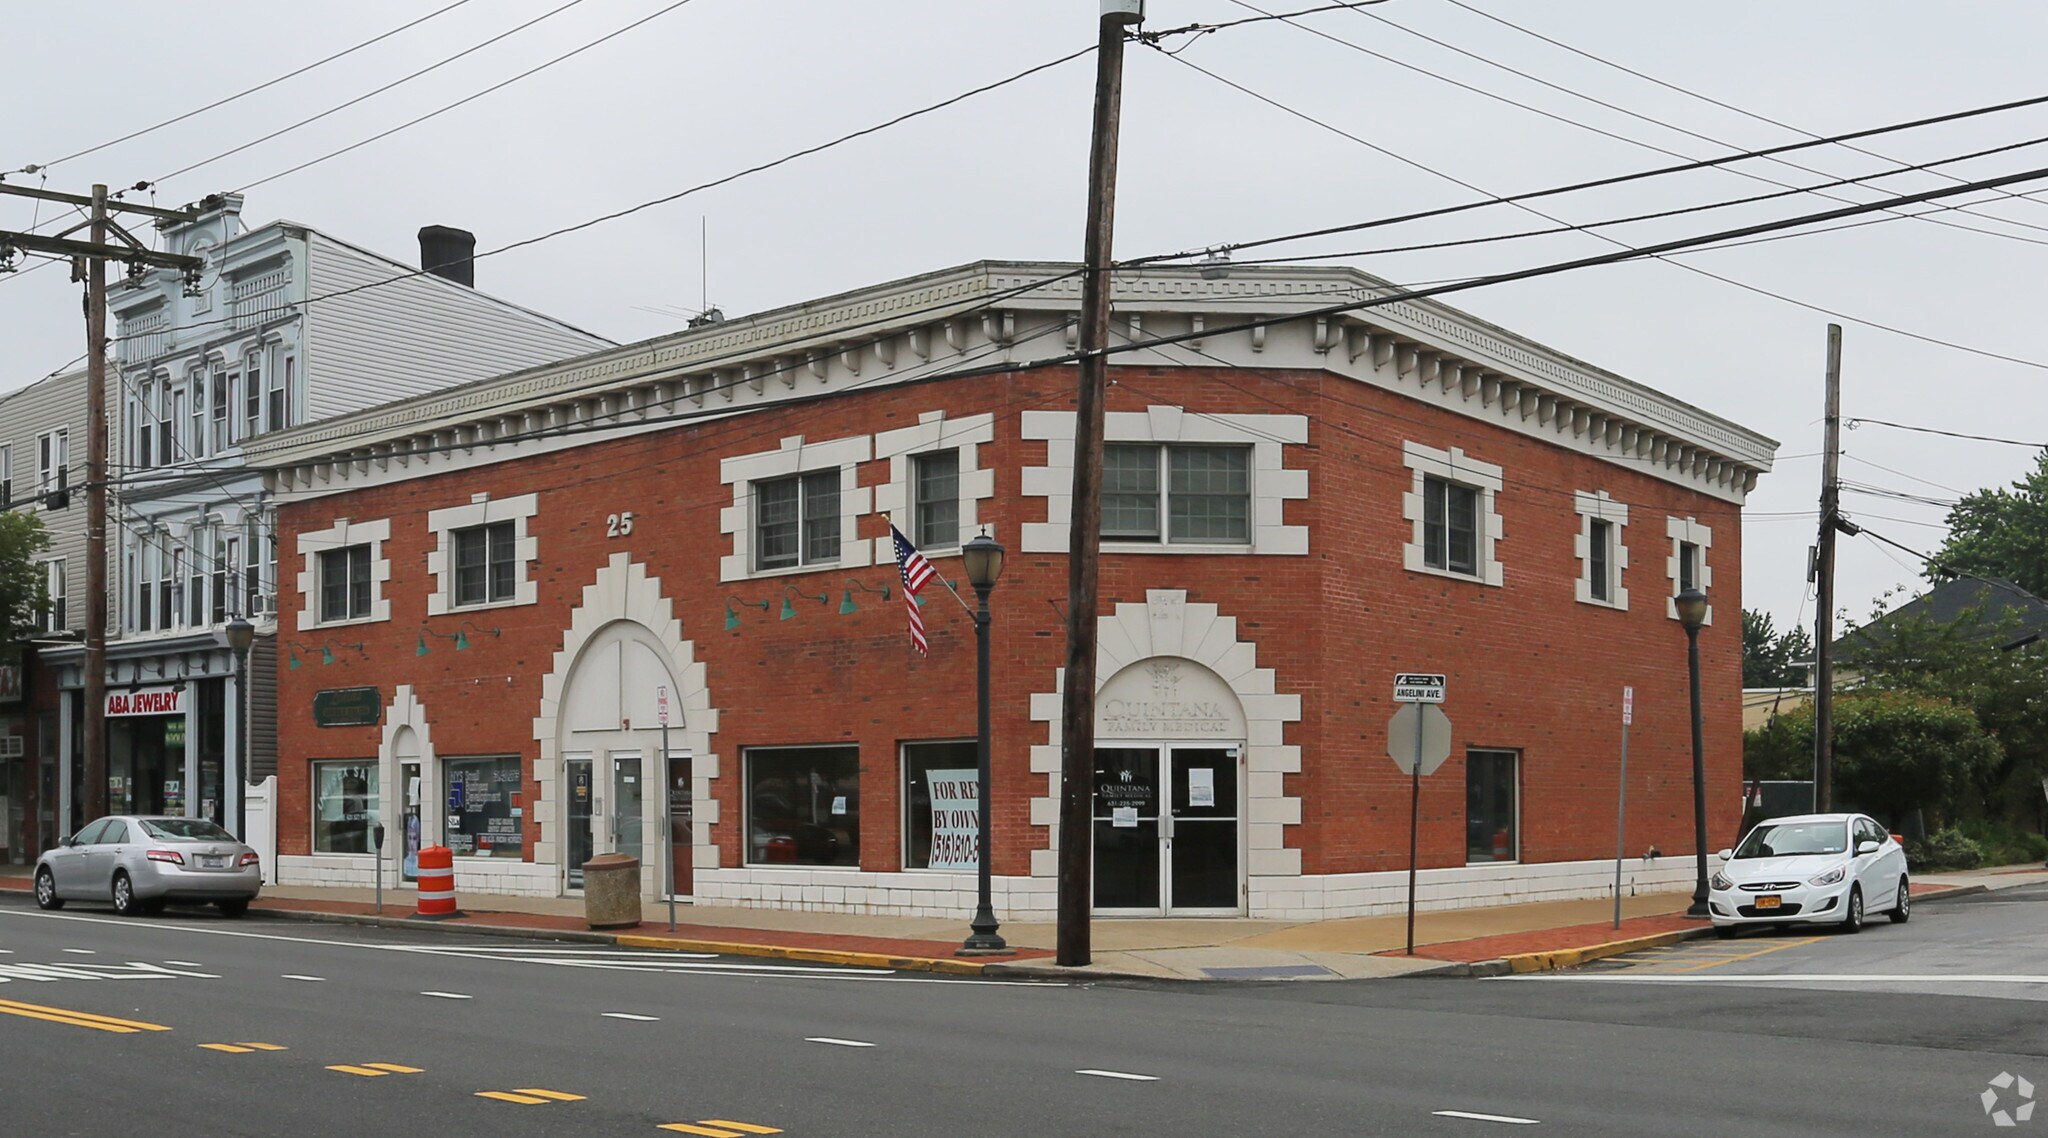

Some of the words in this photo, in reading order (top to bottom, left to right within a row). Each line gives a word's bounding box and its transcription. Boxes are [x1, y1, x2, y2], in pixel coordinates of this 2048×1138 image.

[607, 512, 633, 537] 25
[1397, 688, 1425, 697] ANGELINI
[108, 695, 130, 714] ABA
[132, 692, 178, 712] JEWELRY
[1105, 700, 1222, 720] QUINTANA
[1107, 722, 1157, 732] FAMILY
[1163, 722, 1227, 732] MEDICAL
[933, 782, 958, 799] FOR
[1101, 784, 1151, 794] QUINTANA
[934, 810, 948, 828] BY
